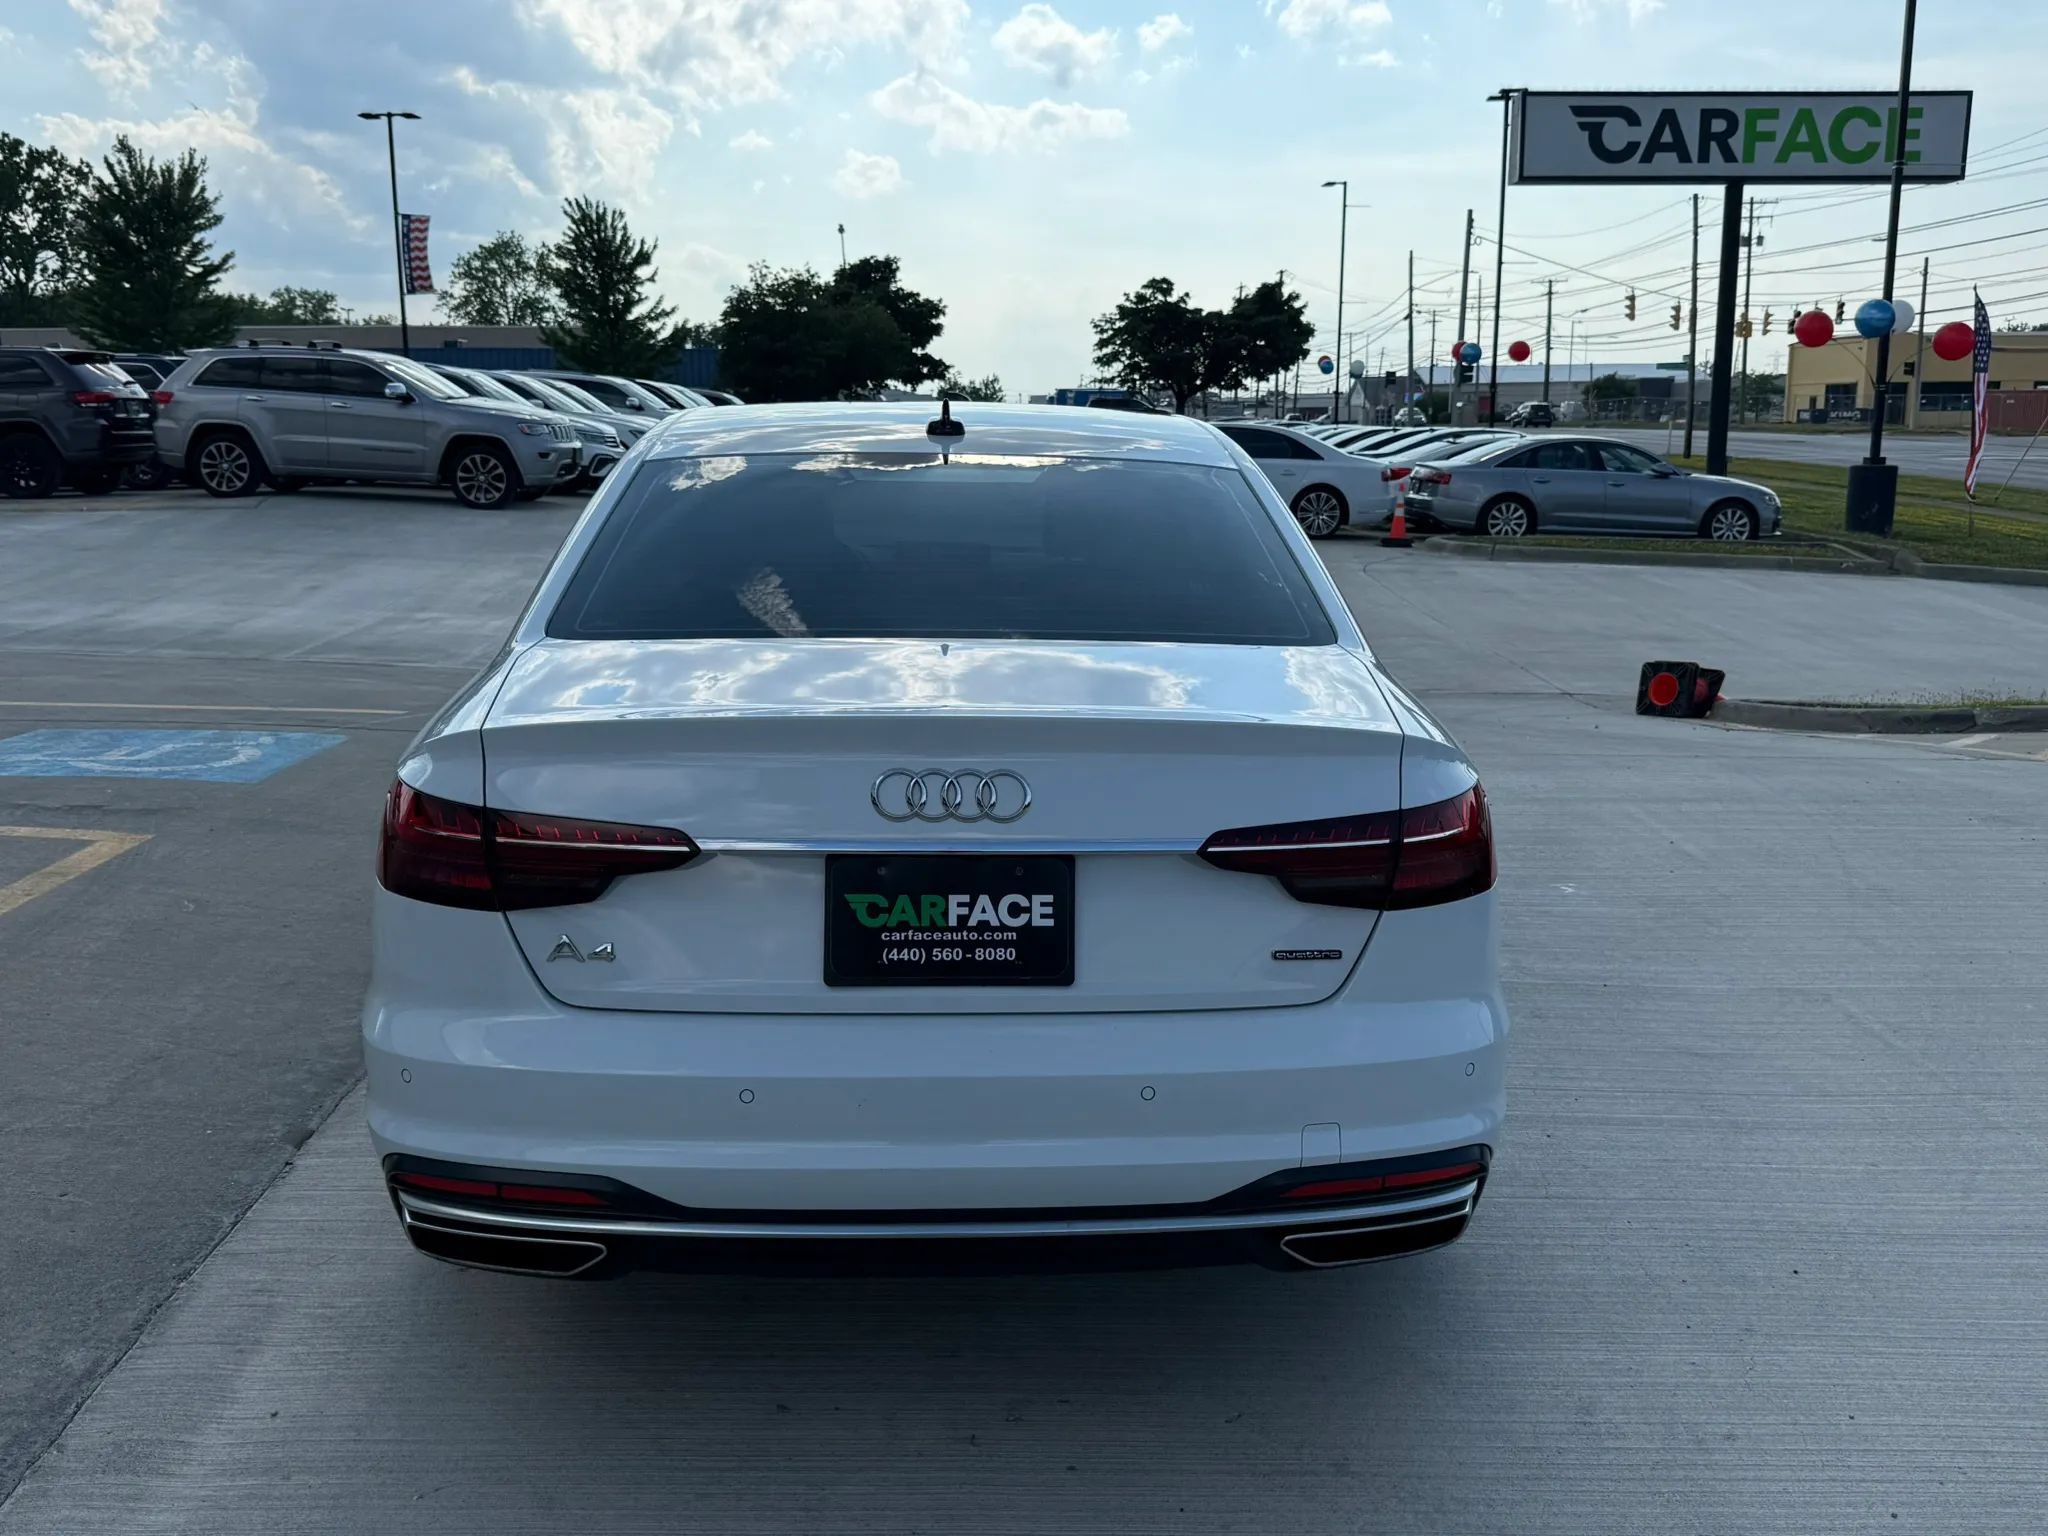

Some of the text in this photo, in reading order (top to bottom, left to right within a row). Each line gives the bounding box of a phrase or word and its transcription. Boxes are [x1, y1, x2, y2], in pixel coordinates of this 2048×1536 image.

[1569, 105, 1924, 164] CARFACE
[844, 894, 1054, 927] CARFACE
[881, 930, 1017, 941] carfaceauto.com
[546, 934, 616, 962] A4
[882, 948, 1016, 964] (440) 560-8080
[1275, 951, 1340, 960] quattro
